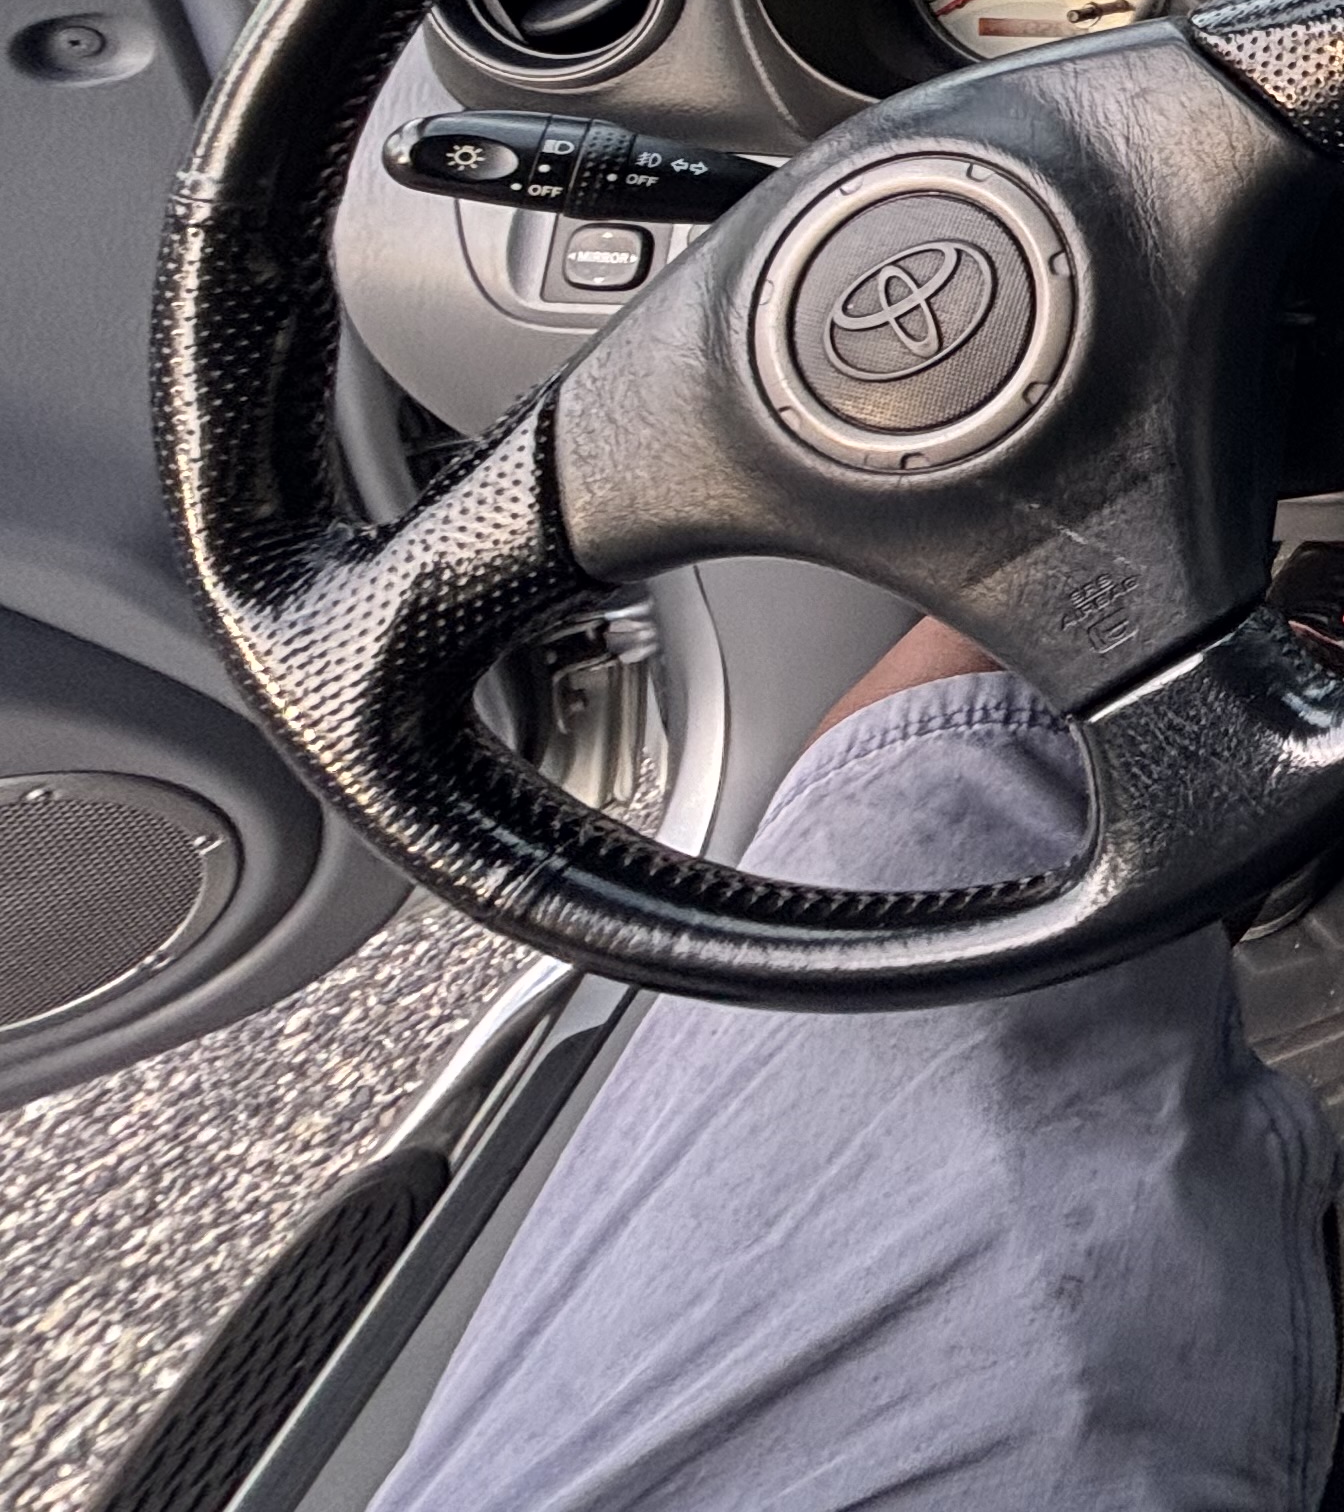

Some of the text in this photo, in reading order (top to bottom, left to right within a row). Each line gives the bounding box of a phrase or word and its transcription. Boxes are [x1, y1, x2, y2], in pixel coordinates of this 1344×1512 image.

[626, 173, 659, 187] OFF
[527, 184, 563, 198] OFF
[577, 251, 630, 264] MIRROR
